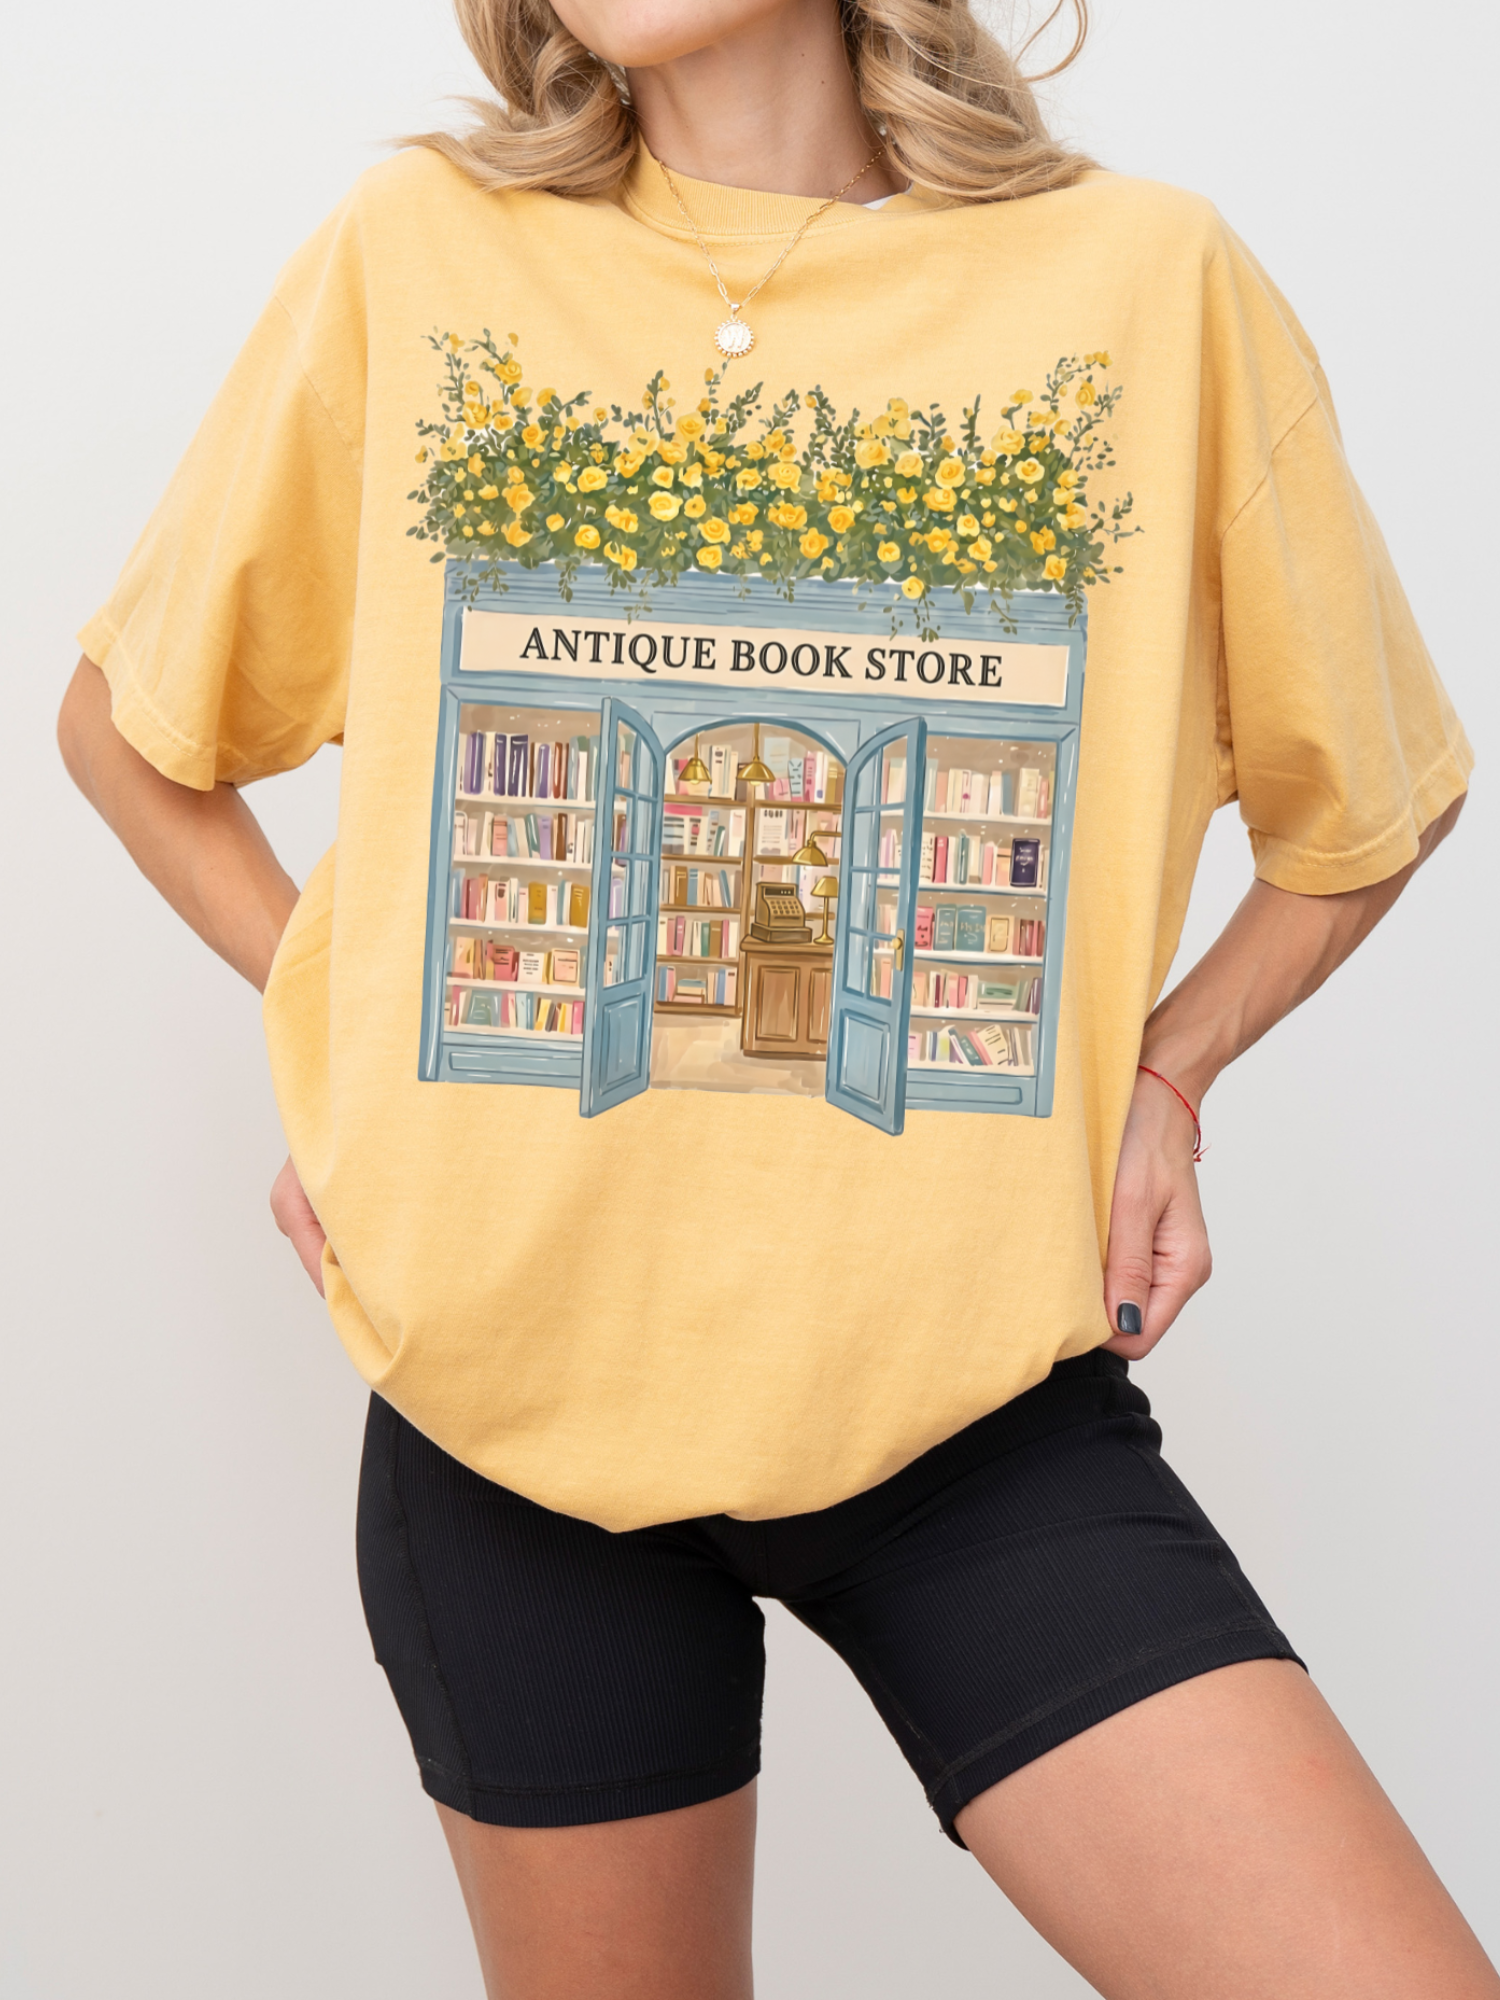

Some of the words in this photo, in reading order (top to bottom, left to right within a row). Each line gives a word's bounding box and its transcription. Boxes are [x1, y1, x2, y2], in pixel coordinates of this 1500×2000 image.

[519, 627, 716, 674] ANTIQUE
[729, 639, 853, 679] BOOK
[864, 647, 1004, 688] STORE
